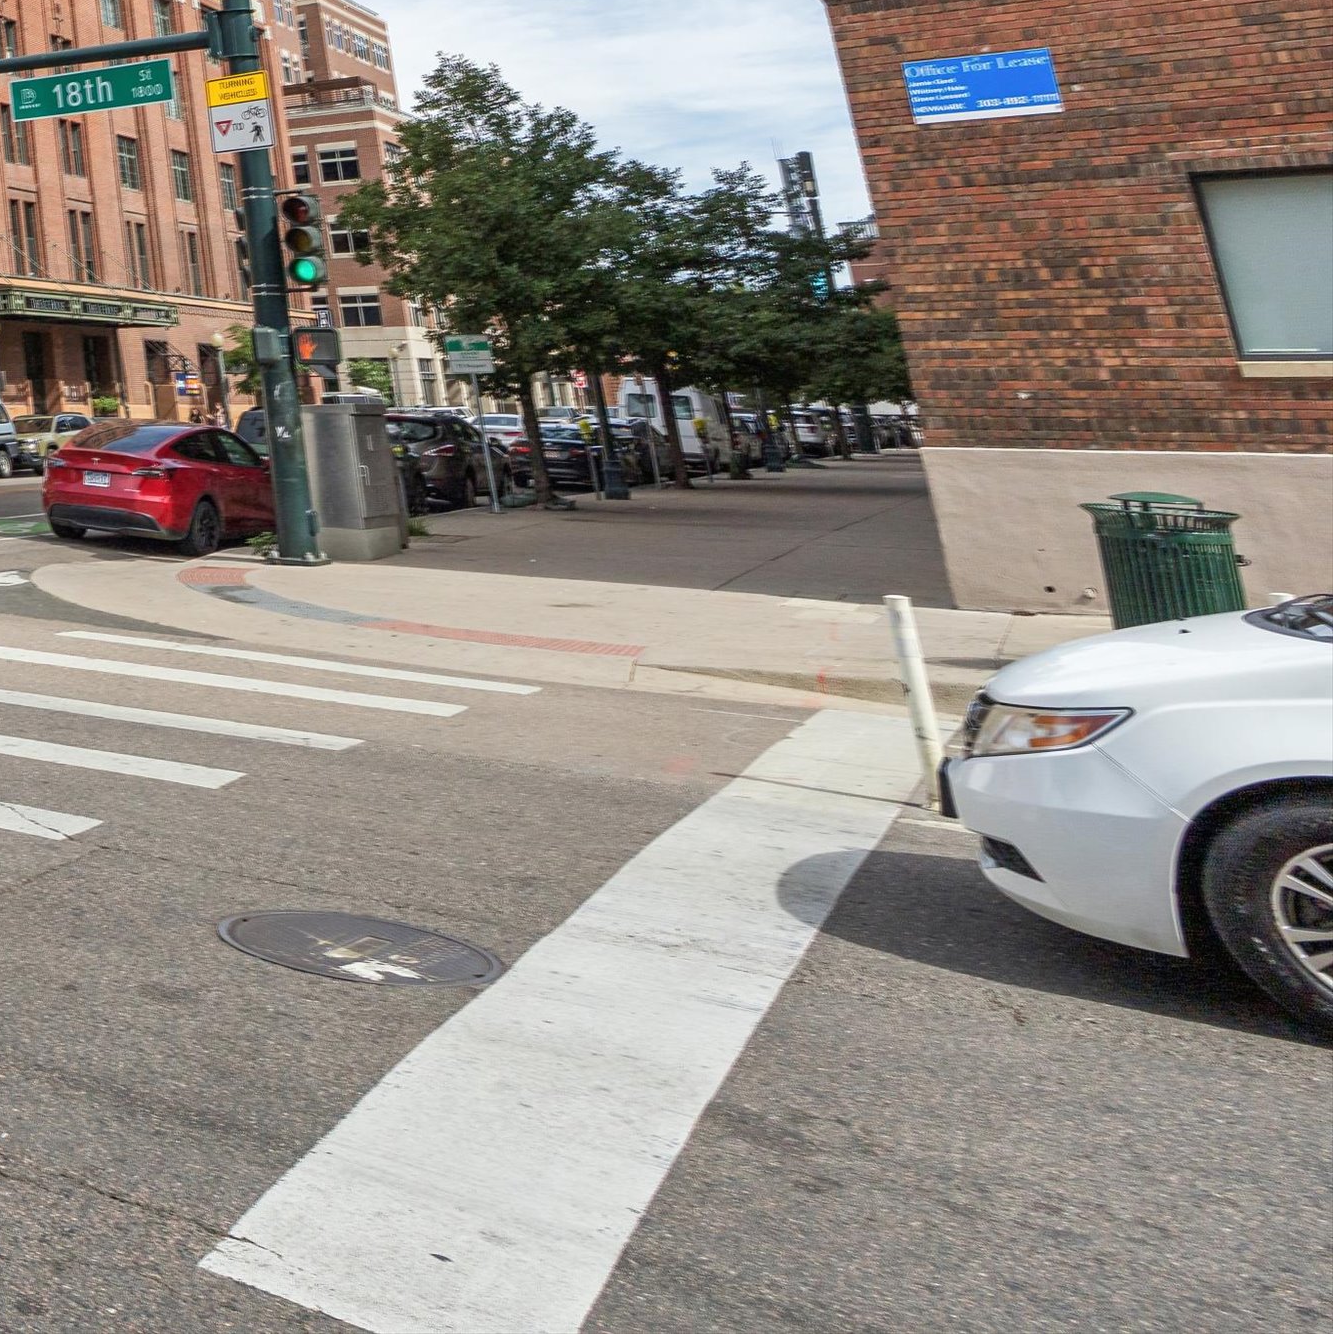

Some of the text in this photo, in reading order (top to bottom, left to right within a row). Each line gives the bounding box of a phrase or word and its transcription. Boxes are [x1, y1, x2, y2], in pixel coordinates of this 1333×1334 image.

[138, 68, 152, 81] St
[904, 56, 1049, 78] Office For Lease
[131, 83, 163, 98] 1800
[218, 78, 255, 90] TURNING
[52, 76, 114, 108] 18th
